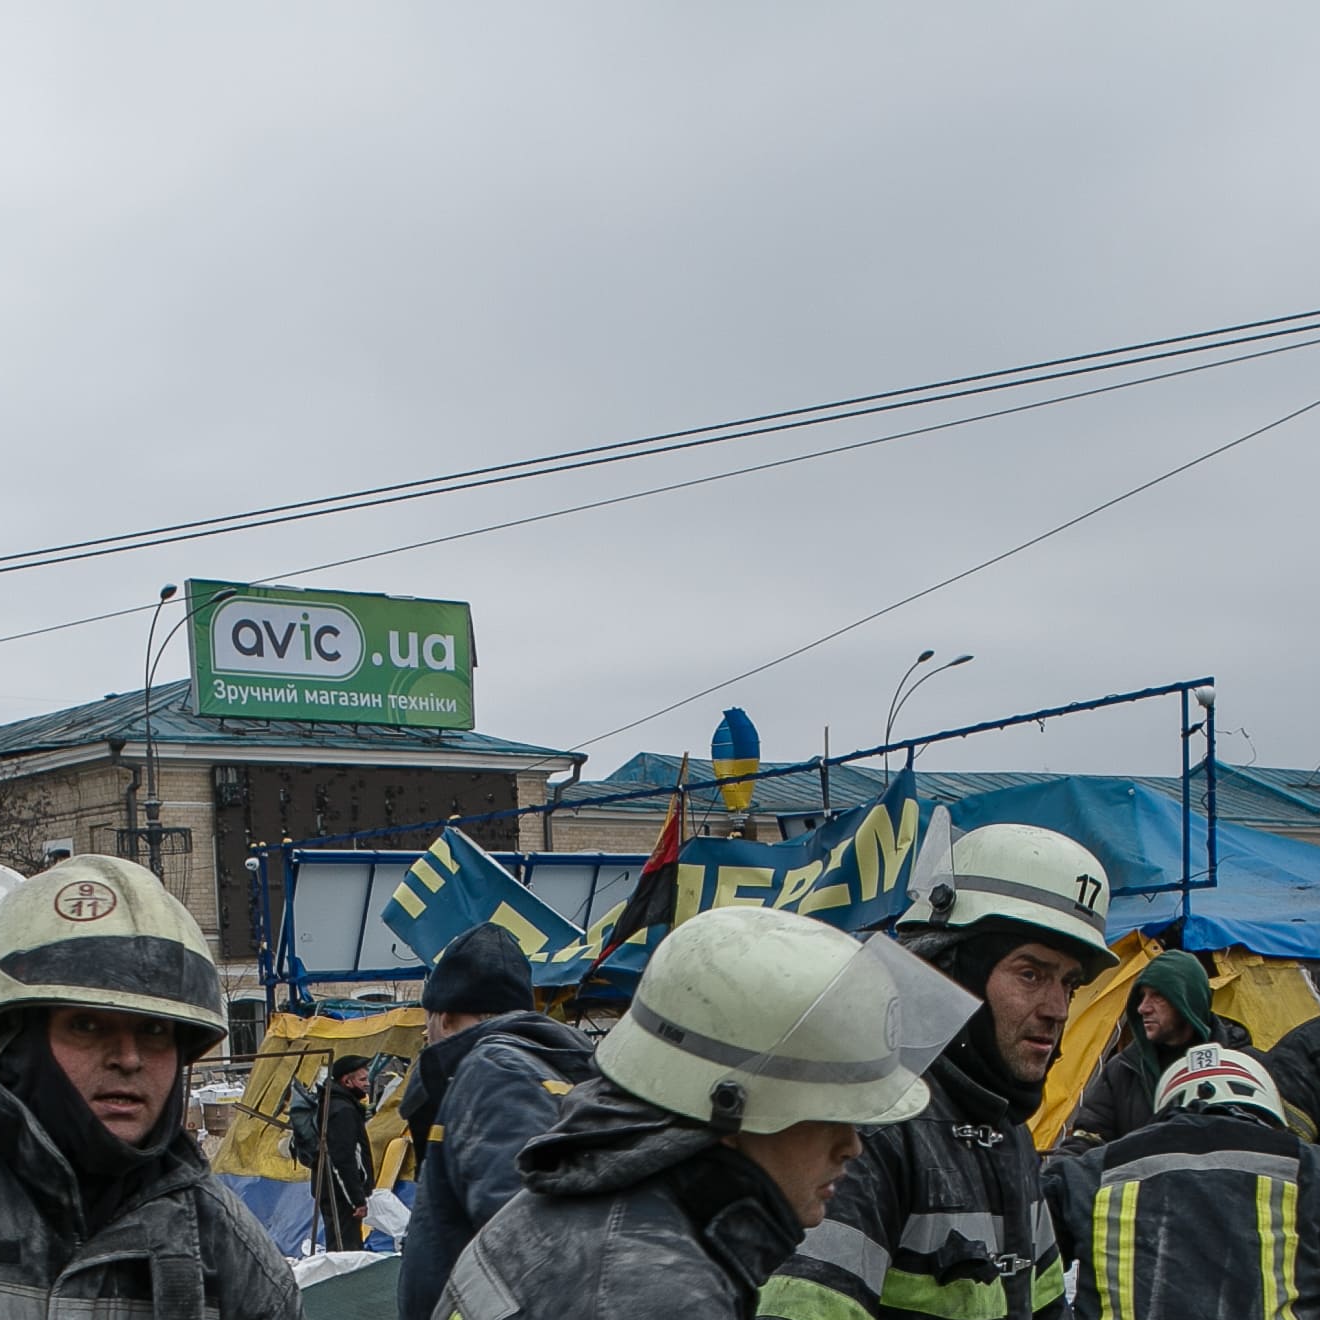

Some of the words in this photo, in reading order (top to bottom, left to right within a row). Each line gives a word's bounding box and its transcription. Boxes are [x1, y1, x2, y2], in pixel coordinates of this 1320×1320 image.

[214, 680, 298, 705] Зручний
[305, 689, 382, 708] магазин
[389, 691, 457, 713] техніки
[80, 884, 94, 896] 9
[1075, 874, 1102, 909] 17
[71, 901, 98, 917] 11
